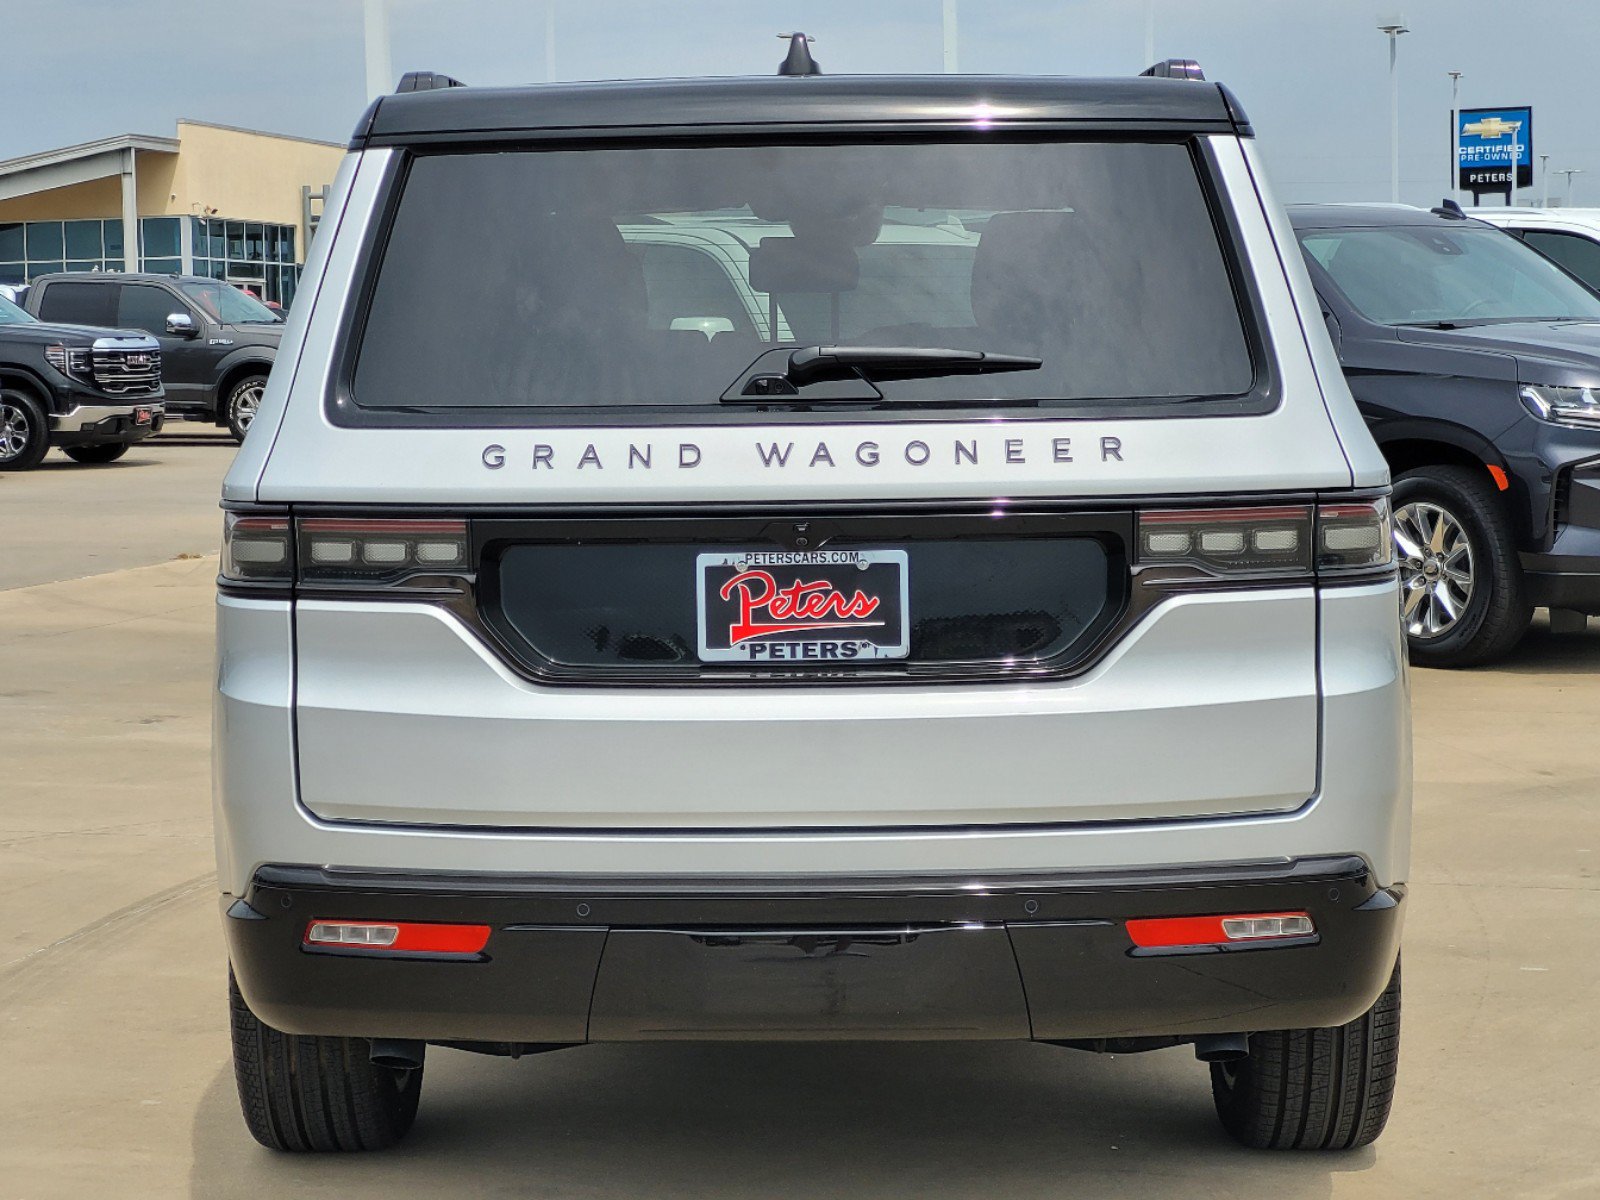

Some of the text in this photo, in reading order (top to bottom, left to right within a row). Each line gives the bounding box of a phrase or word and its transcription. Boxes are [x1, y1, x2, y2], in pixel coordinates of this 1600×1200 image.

[1470, 173, 1512, 182] PETERS
[481, 436, 1124, 470] GRAND WAGONEER
[745, 551, 860, 565] PETERSCARS.COM
[720, 569, 880, 630] Peters
[749, 642, 858, 660] PETERS
